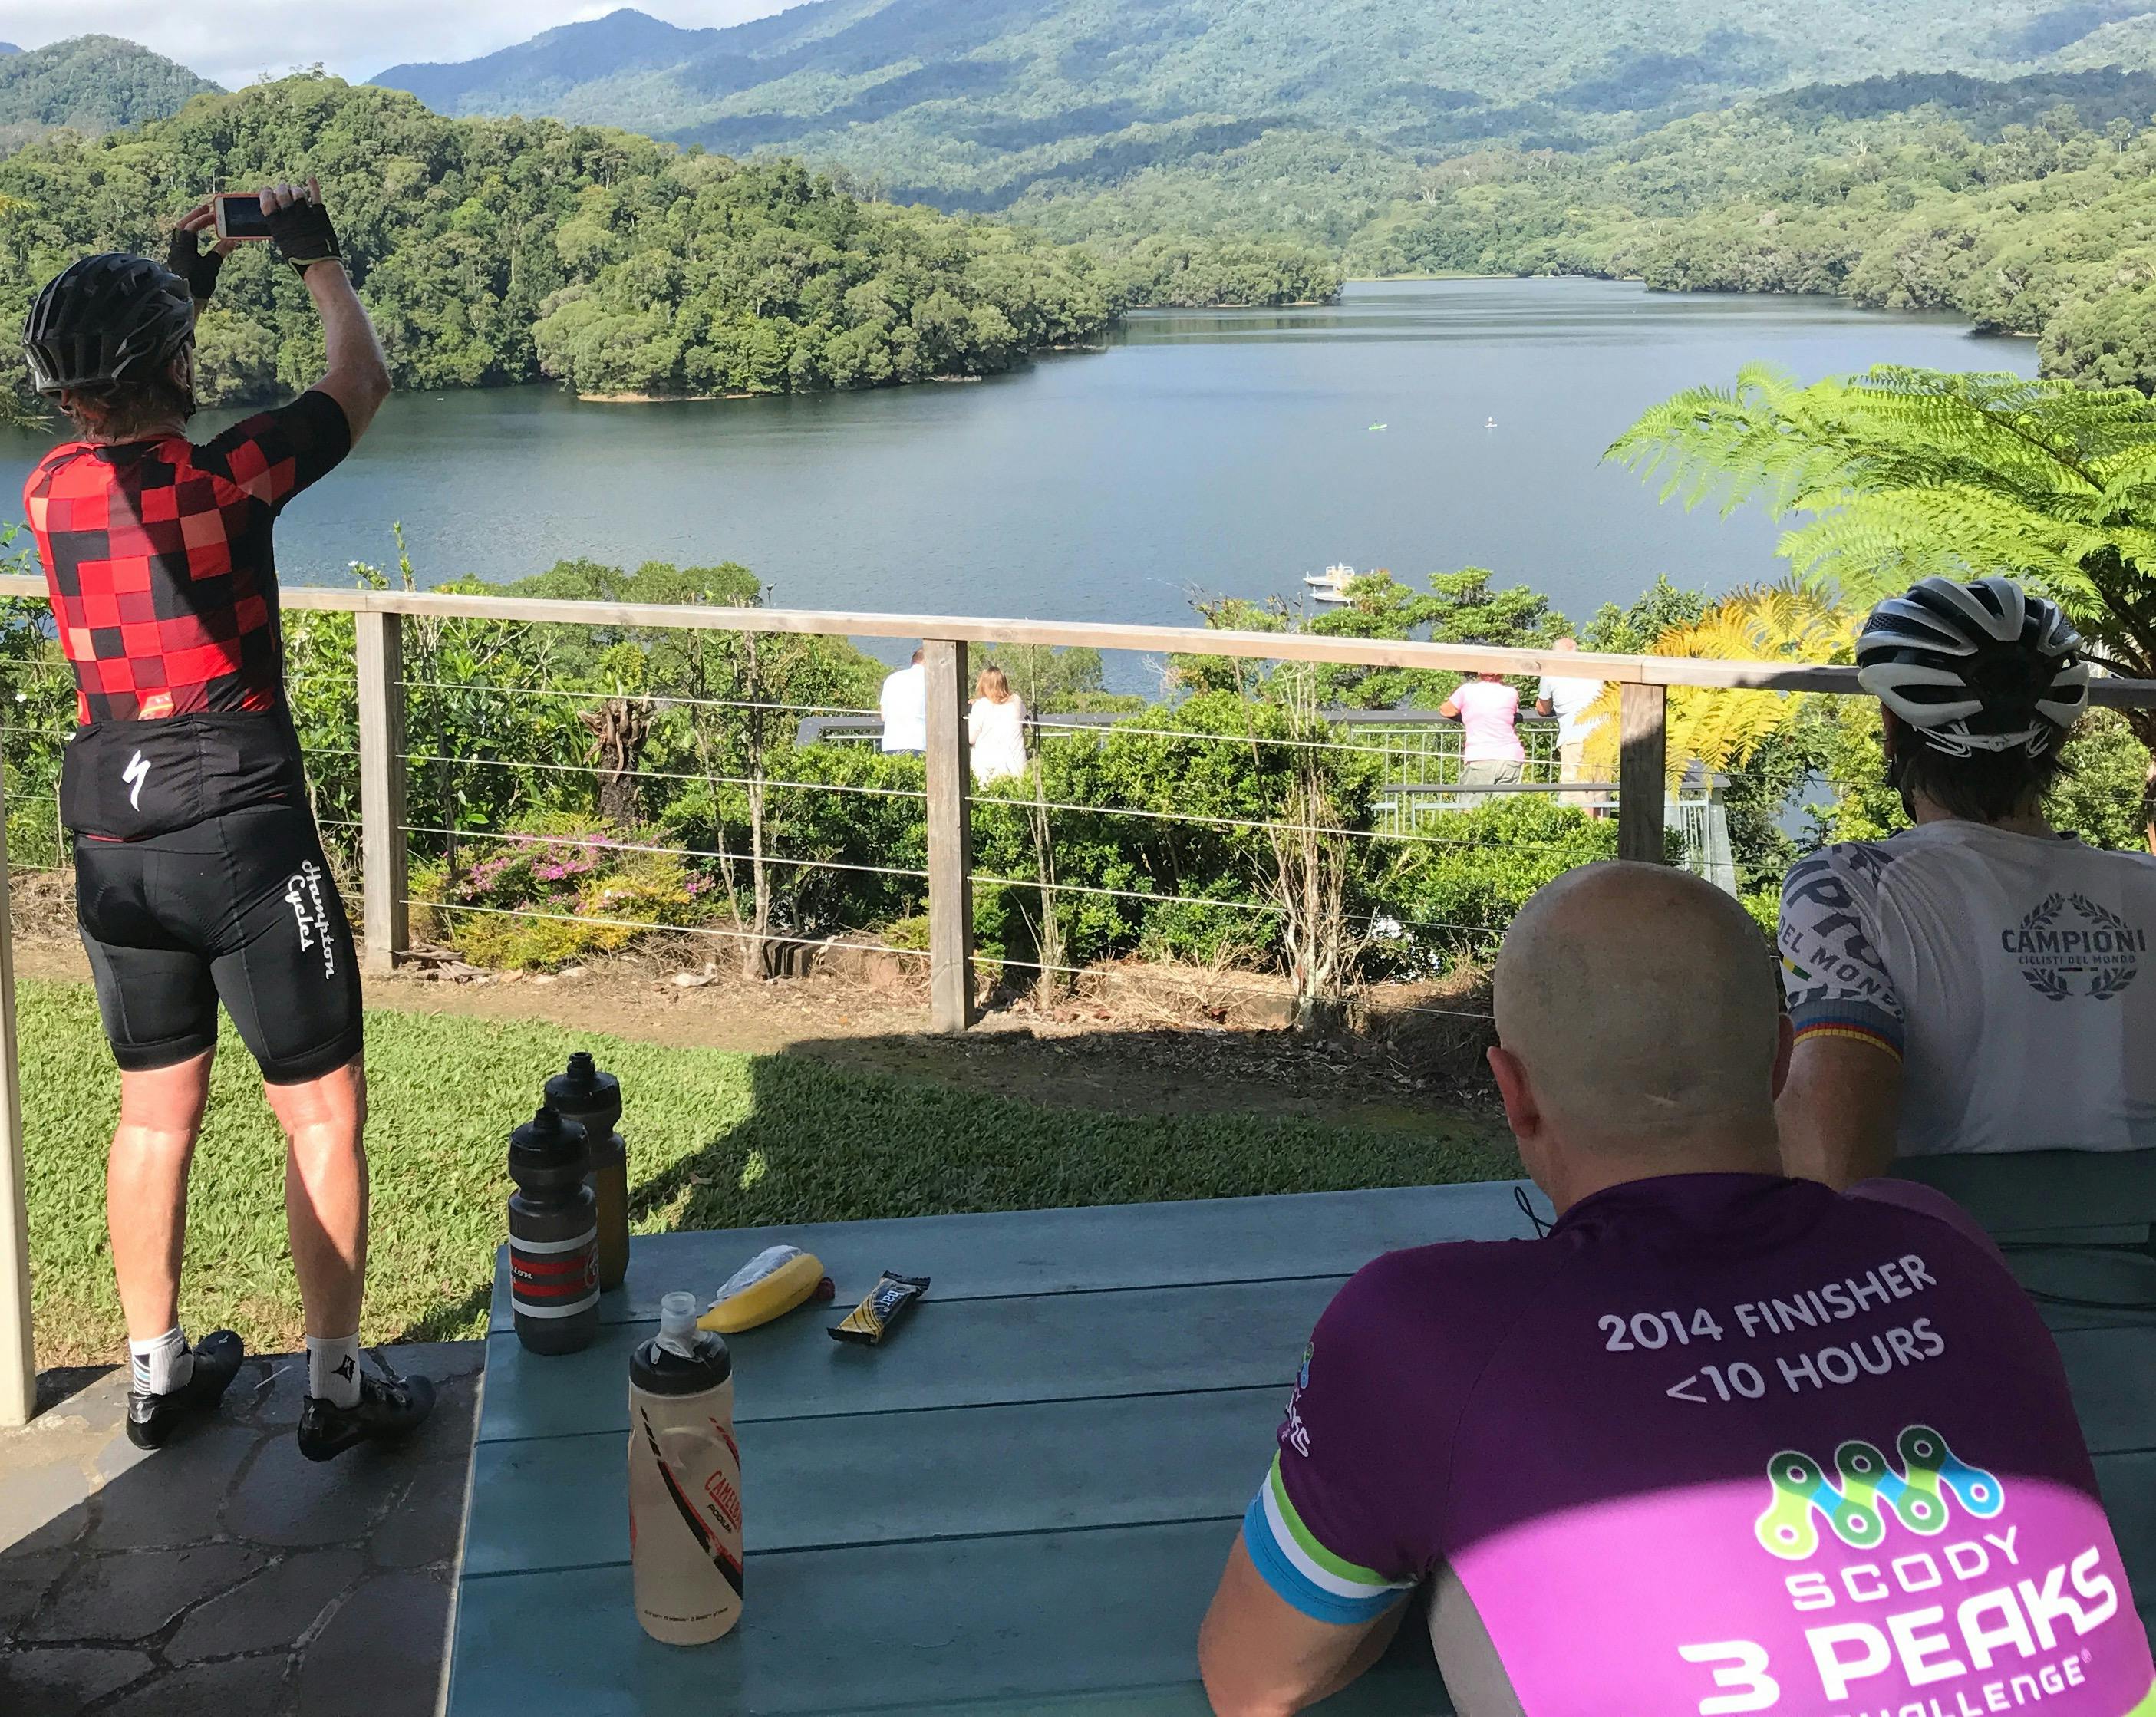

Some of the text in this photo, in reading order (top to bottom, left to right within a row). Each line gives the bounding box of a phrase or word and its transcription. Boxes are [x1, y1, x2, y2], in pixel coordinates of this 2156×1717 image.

[285, 875, 315, 953] Cycles
[302, 859, 335, 980] Hampton
[2001, 929, 2146, 953] CAMPIONI
[1597, 1254, 1937, 1352] 2014 FINISHER
[1665, 1317, 1946, 1404] <10 HOURS
[1784, 1525, 2021, 1611] SCODY
[1677, 1545, 2119, 1716] 3 PEAKS
[1834, 1655, 2086, 1717] ALLENGE
